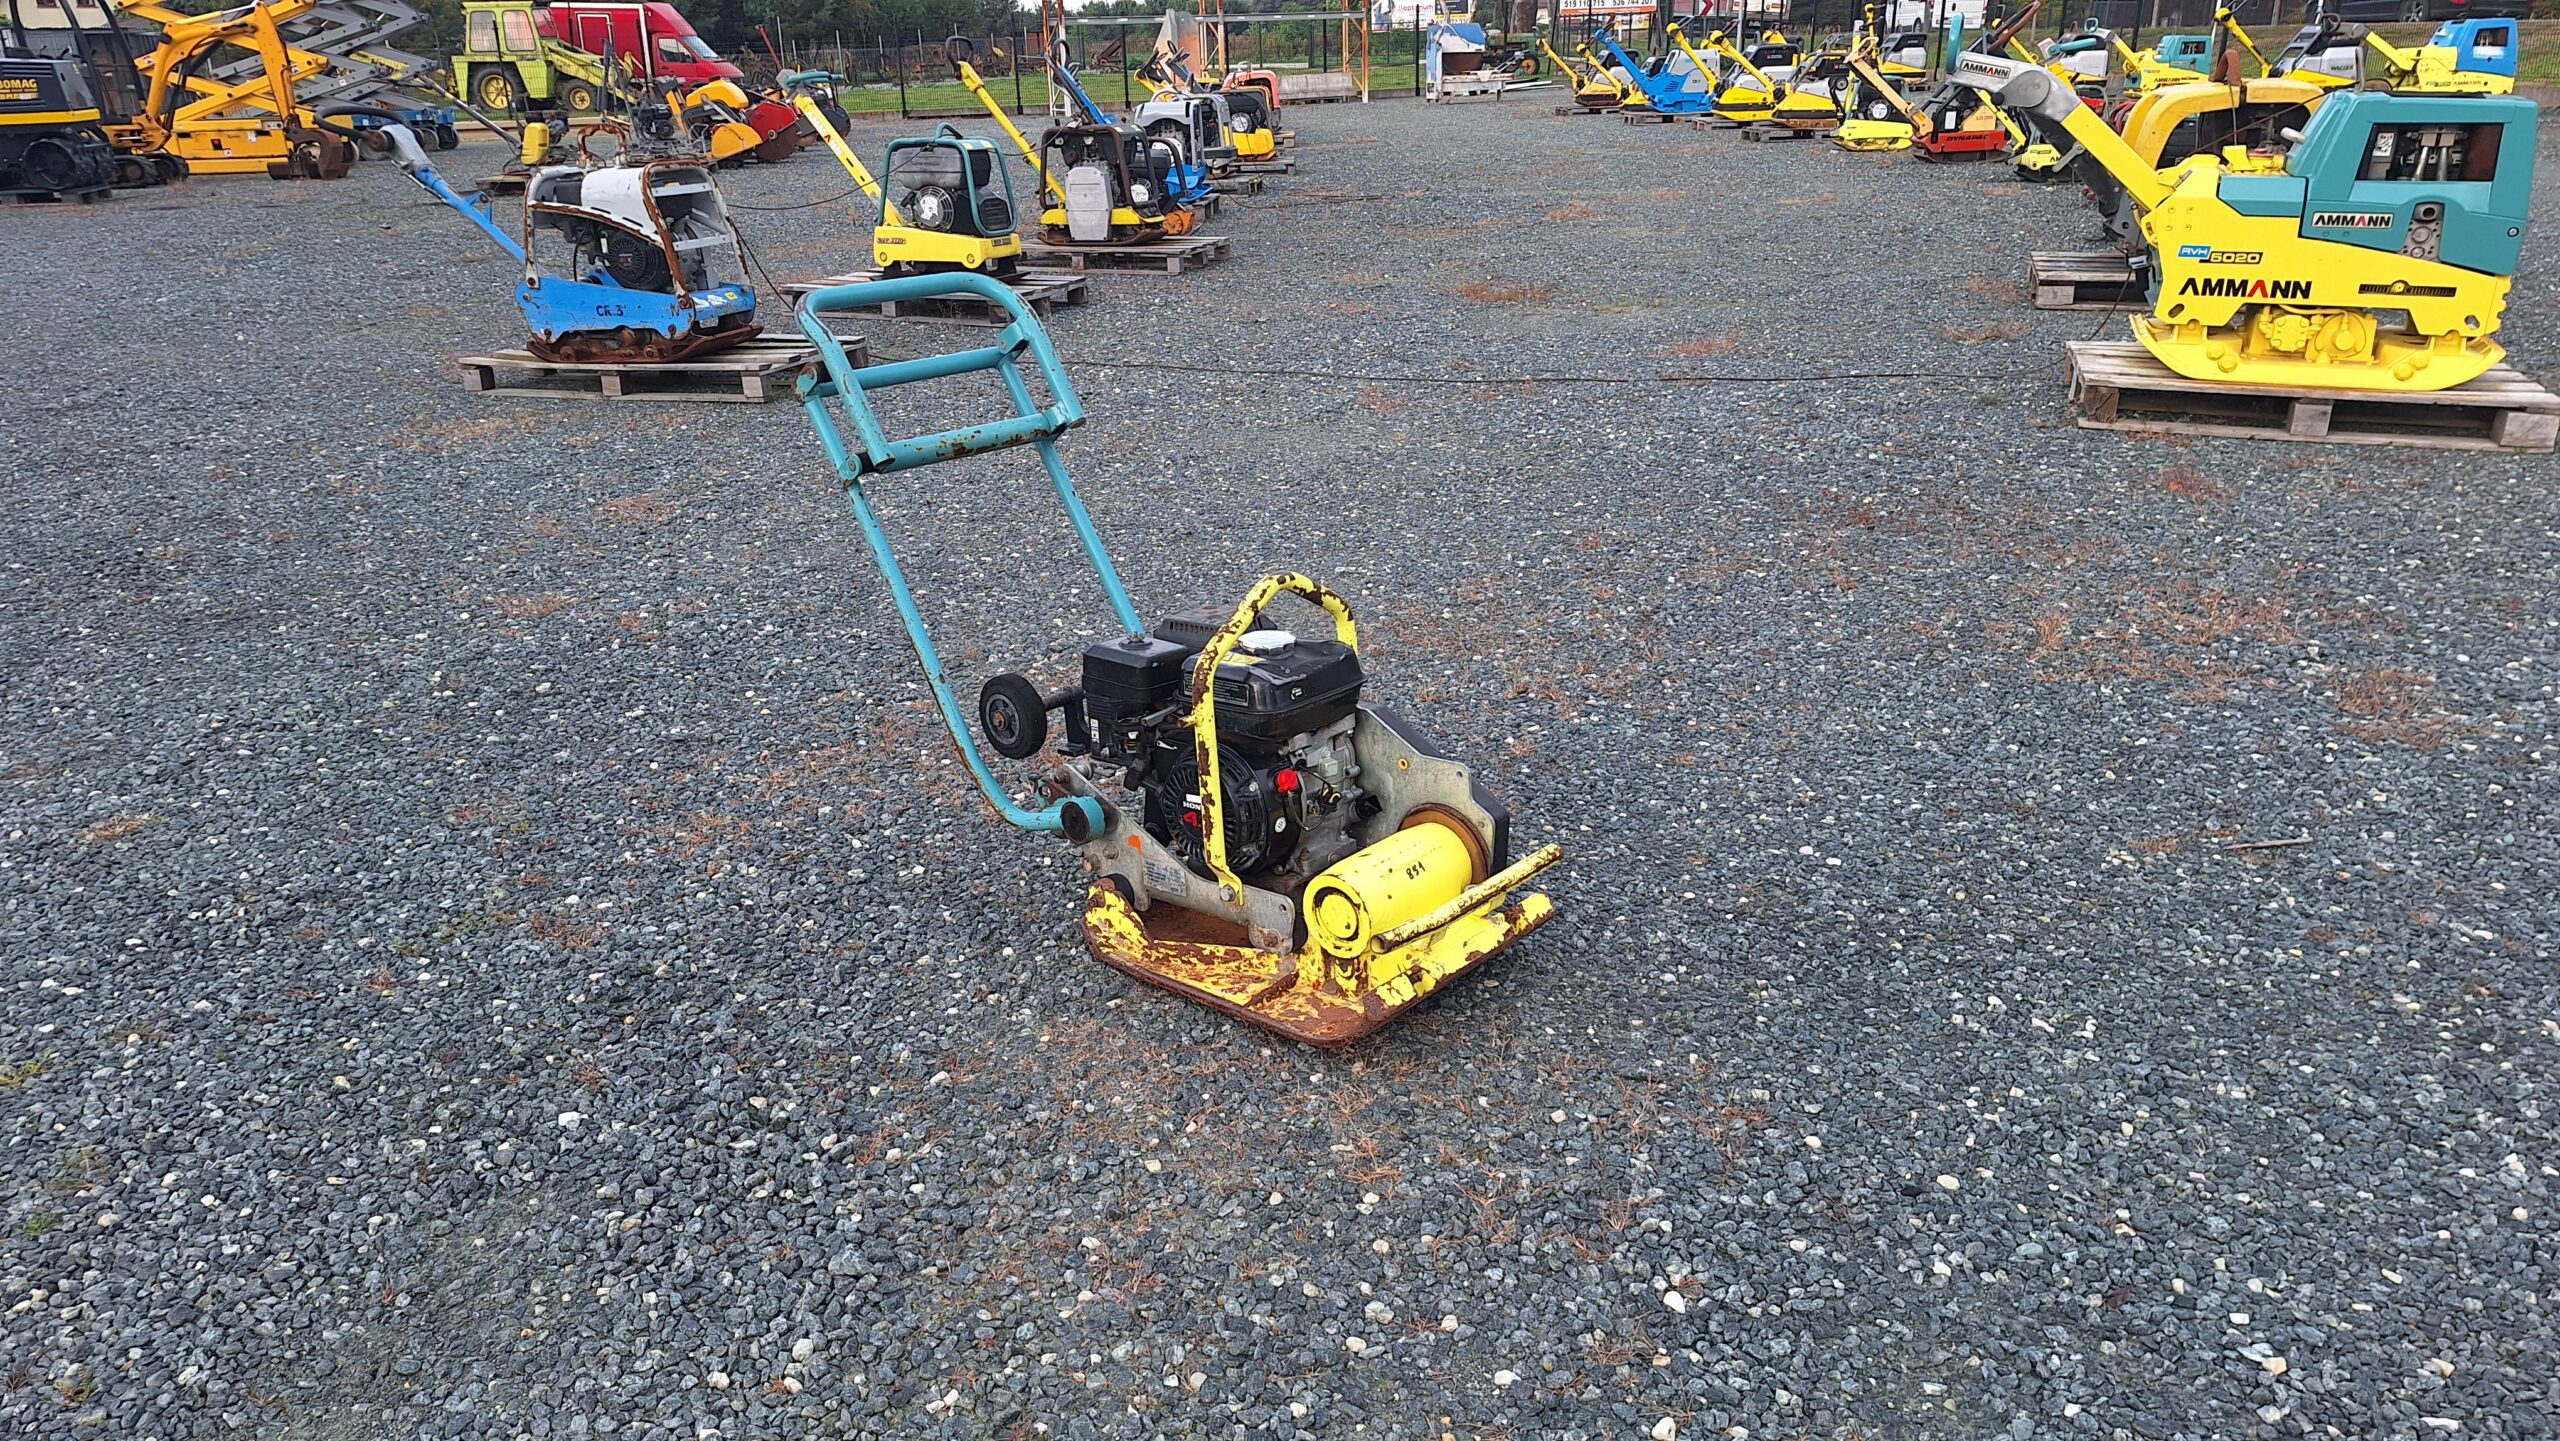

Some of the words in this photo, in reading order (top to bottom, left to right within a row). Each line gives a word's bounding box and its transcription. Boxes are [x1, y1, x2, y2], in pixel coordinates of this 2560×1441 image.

[1962, 62, 2009, 77] AMMANN
[2314, 215, 2391, 228] AMMANN
[2180, 247, 2209, 256] AVH
[2210, 253, 2261, 263] 5020
[2178, 277, 2313, 300] AMMANN
[1183, 801, 1202, 811] HON
[1406, 861, 1426, 880] 851
